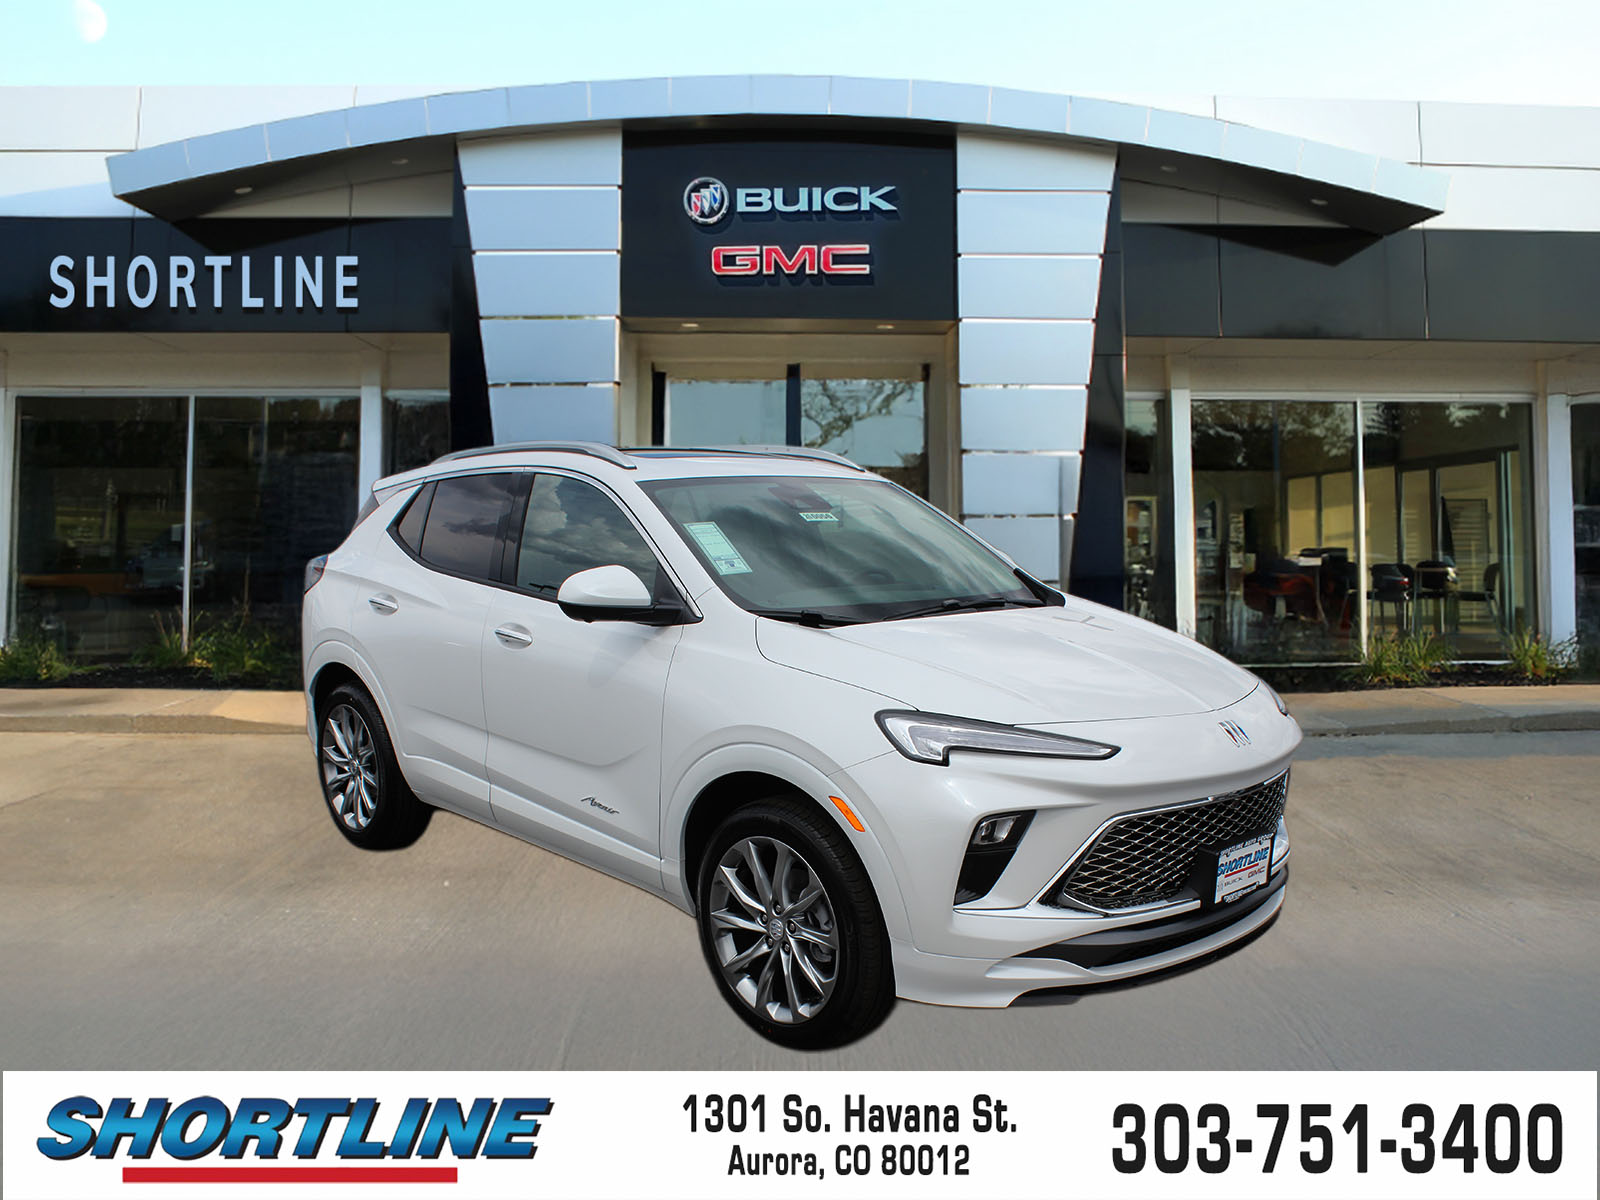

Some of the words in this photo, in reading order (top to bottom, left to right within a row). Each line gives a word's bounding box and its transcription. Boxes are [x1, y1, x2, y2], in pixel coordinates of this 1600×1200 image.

[736, 185, 898, 213] BUICK
[711, 244, 870, 275] GMC
[49, 255, 359, 308] SHORTLINE
[1217, 846, 1270, 877] SHORTLINE
[1247, 865, 1266, 879] GMC
